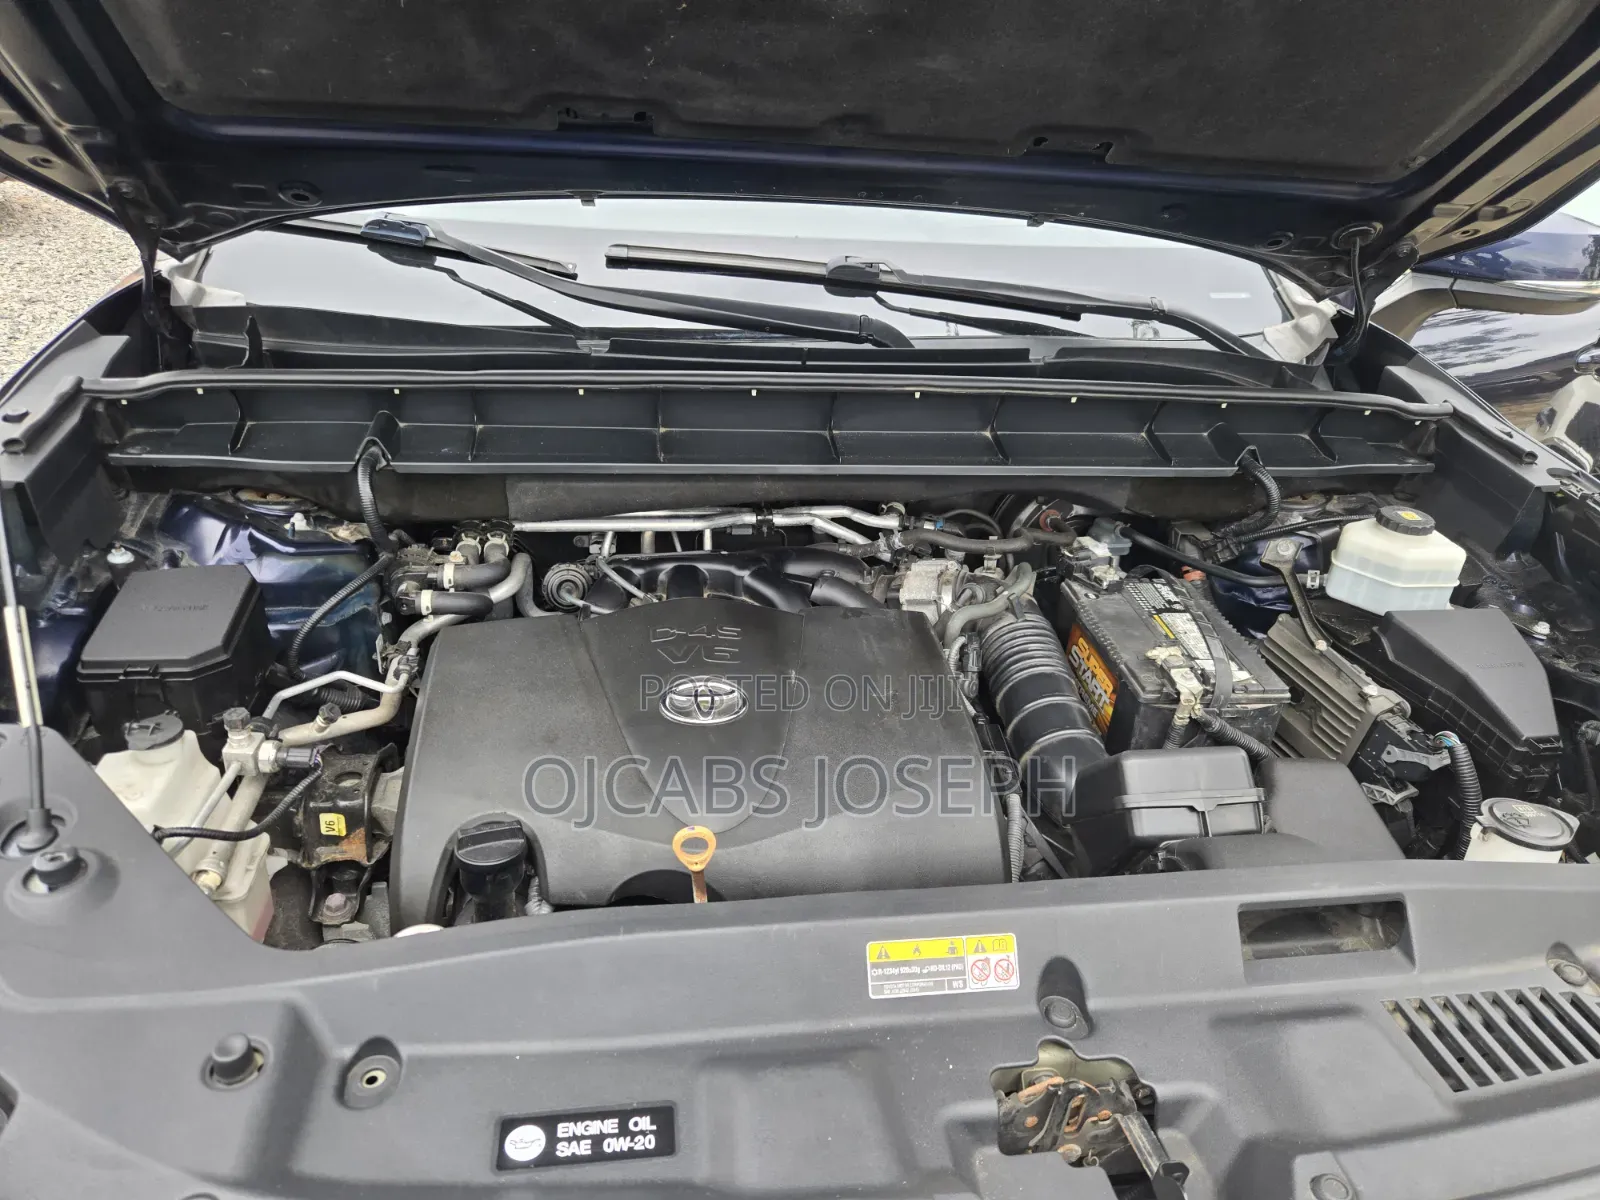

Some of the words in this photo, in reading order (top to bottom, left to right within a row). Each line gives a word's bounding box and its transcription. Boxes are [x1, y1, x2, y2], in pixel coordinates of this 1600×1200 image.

[1068, 644, 1111, 708] START
[1077, 637, 1114, 698] SUPER
[325, 820, 335, 833] V6
[556, 1119, 619, 1138] ENGINE
[628, 1115, 657, 1132] OIL
[555, 1139, 592, 1158] SAE
[602, 1133, 656, 1153] 0W-20
